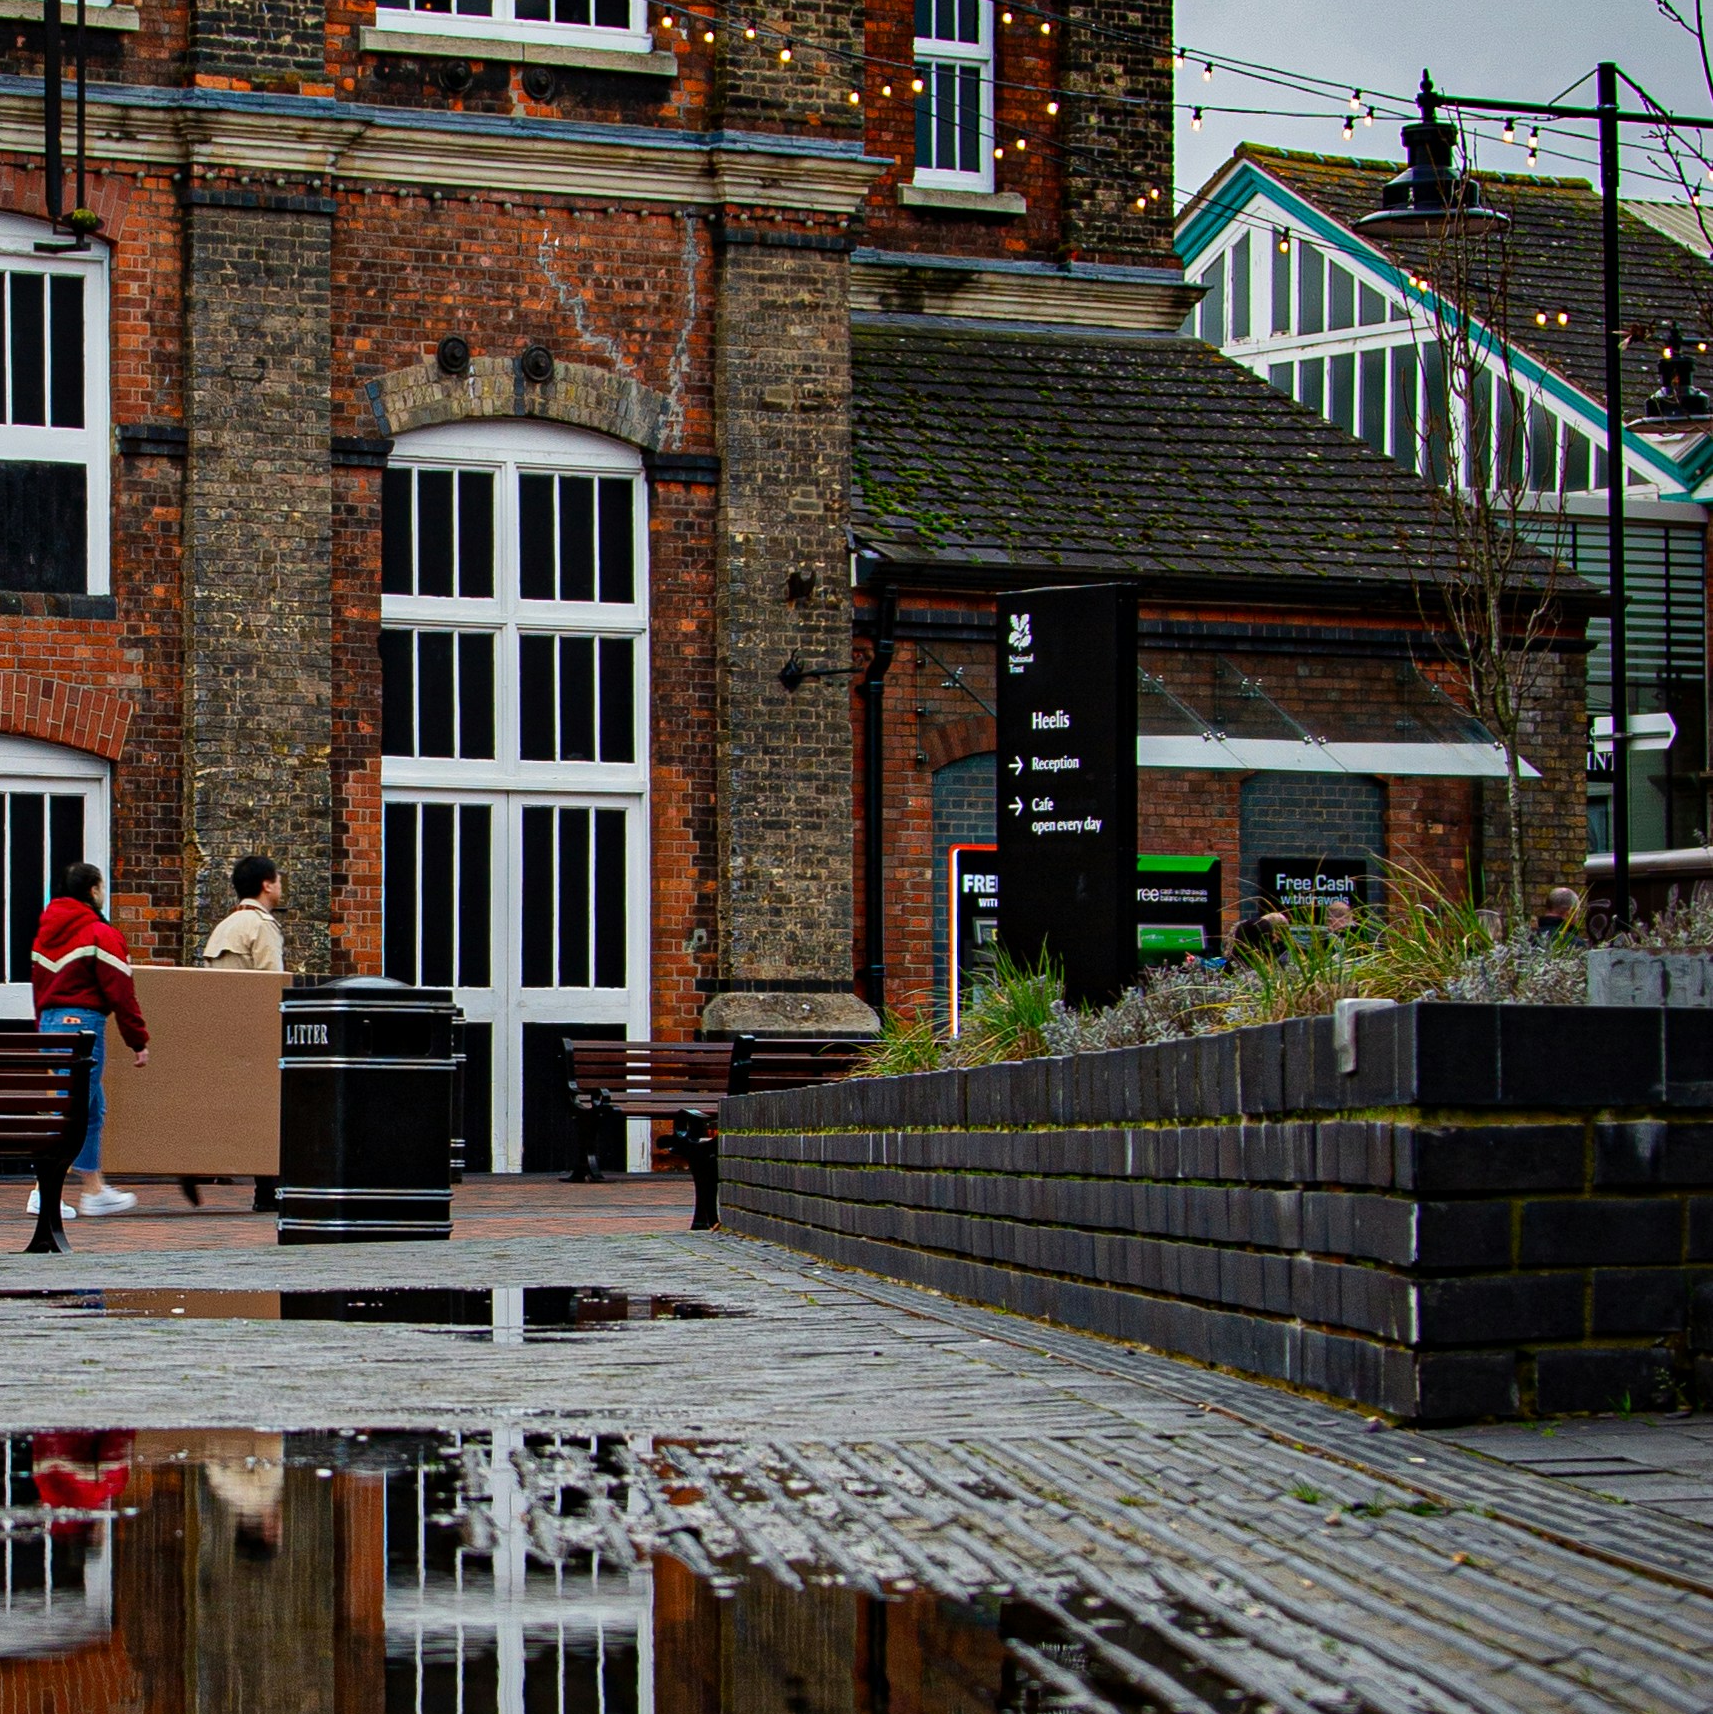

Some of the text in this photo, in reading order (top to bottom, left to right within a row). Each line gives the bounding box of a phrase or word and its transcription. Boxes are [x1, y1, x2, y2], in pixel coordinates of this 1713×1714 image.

[1031, 709, 1070, 729] Heelis
[1031, 755, 1080, 773] Reception
[1031, 797, 1054, 811] Cafe
[1031, 816, 1102, 835] open every day
[963, 874, 998, 893] FRE
[1276, 873, 1354, 892] Free Cash
[286, 1024, 329, 1045] LITTER
